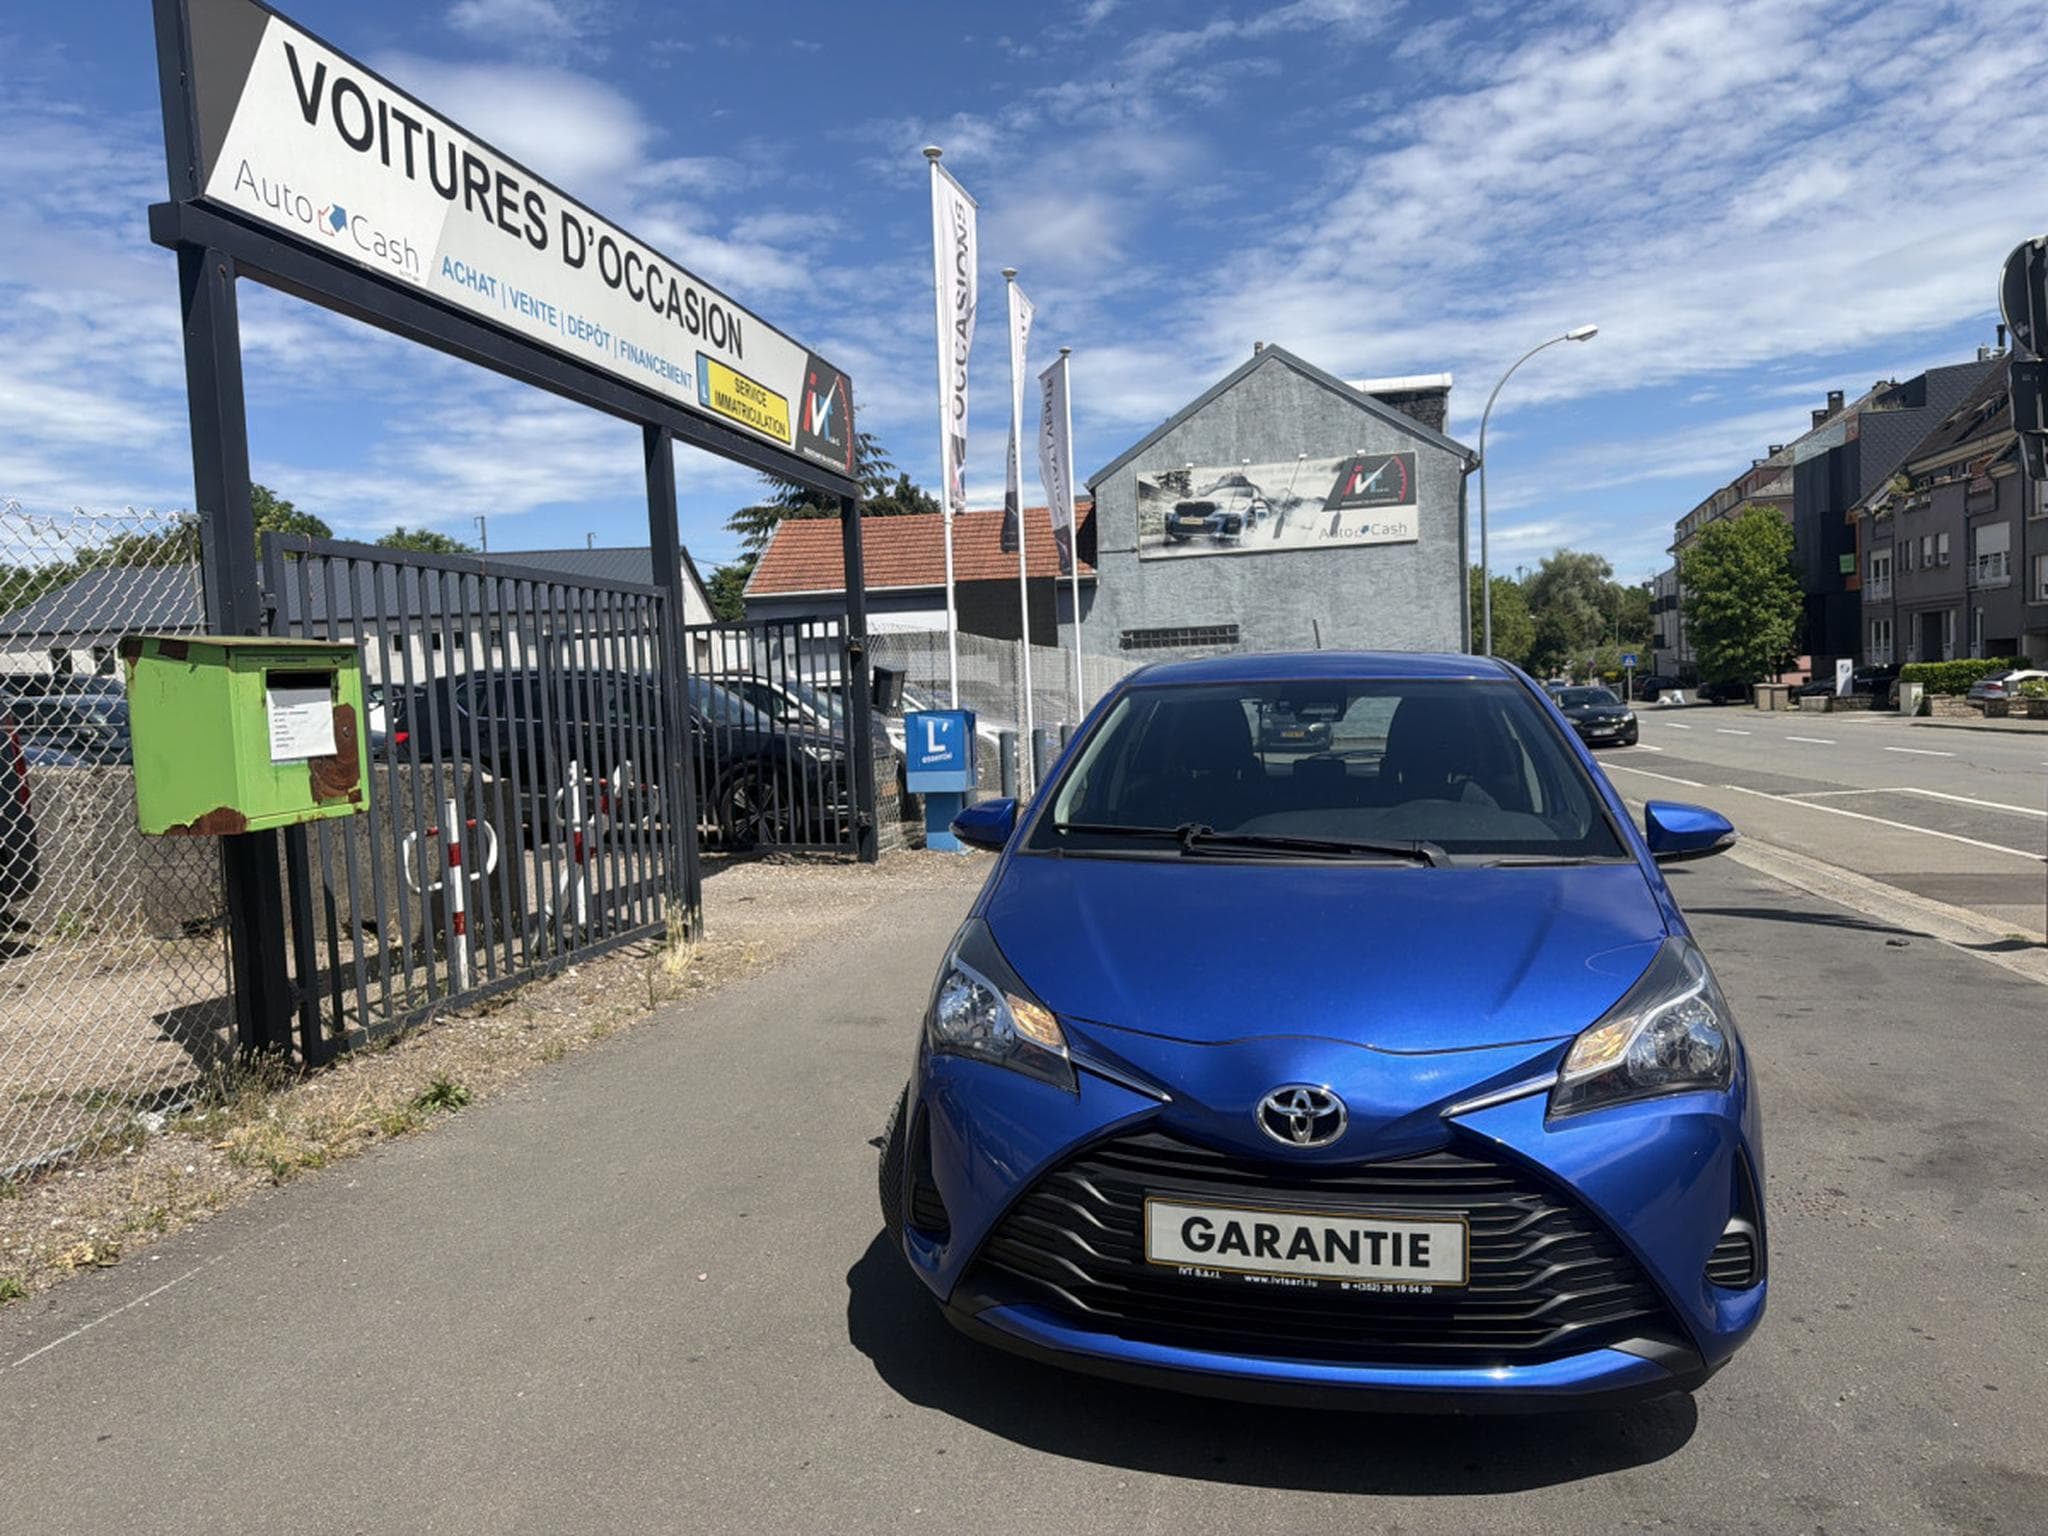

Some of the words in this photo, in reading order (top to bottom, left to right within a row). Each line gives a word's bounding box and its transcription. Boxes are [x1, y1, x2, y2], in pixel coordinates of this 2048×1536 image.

[283, 40, 548, 251] VOITURES
[234, 159, 314, 224] Auto
[351, 214, 420, 273] Cash
[441, 255, 497, 299] ACHAT
[508, 287, 558, 328] VENTE
[567, 315, 611, 351] DÉPÔT
[620, 340, 693, 389] FINANCEMENT
[954, 199, 969, 420] OCCASIONS
[714, 389, 787, 438] IMMATRICULATION
[734, 377, 768, 408] SERVICE
[1371, 522, 1408, 536] Cash
[1181, 1216, 1431, 1268] GARANTIE
